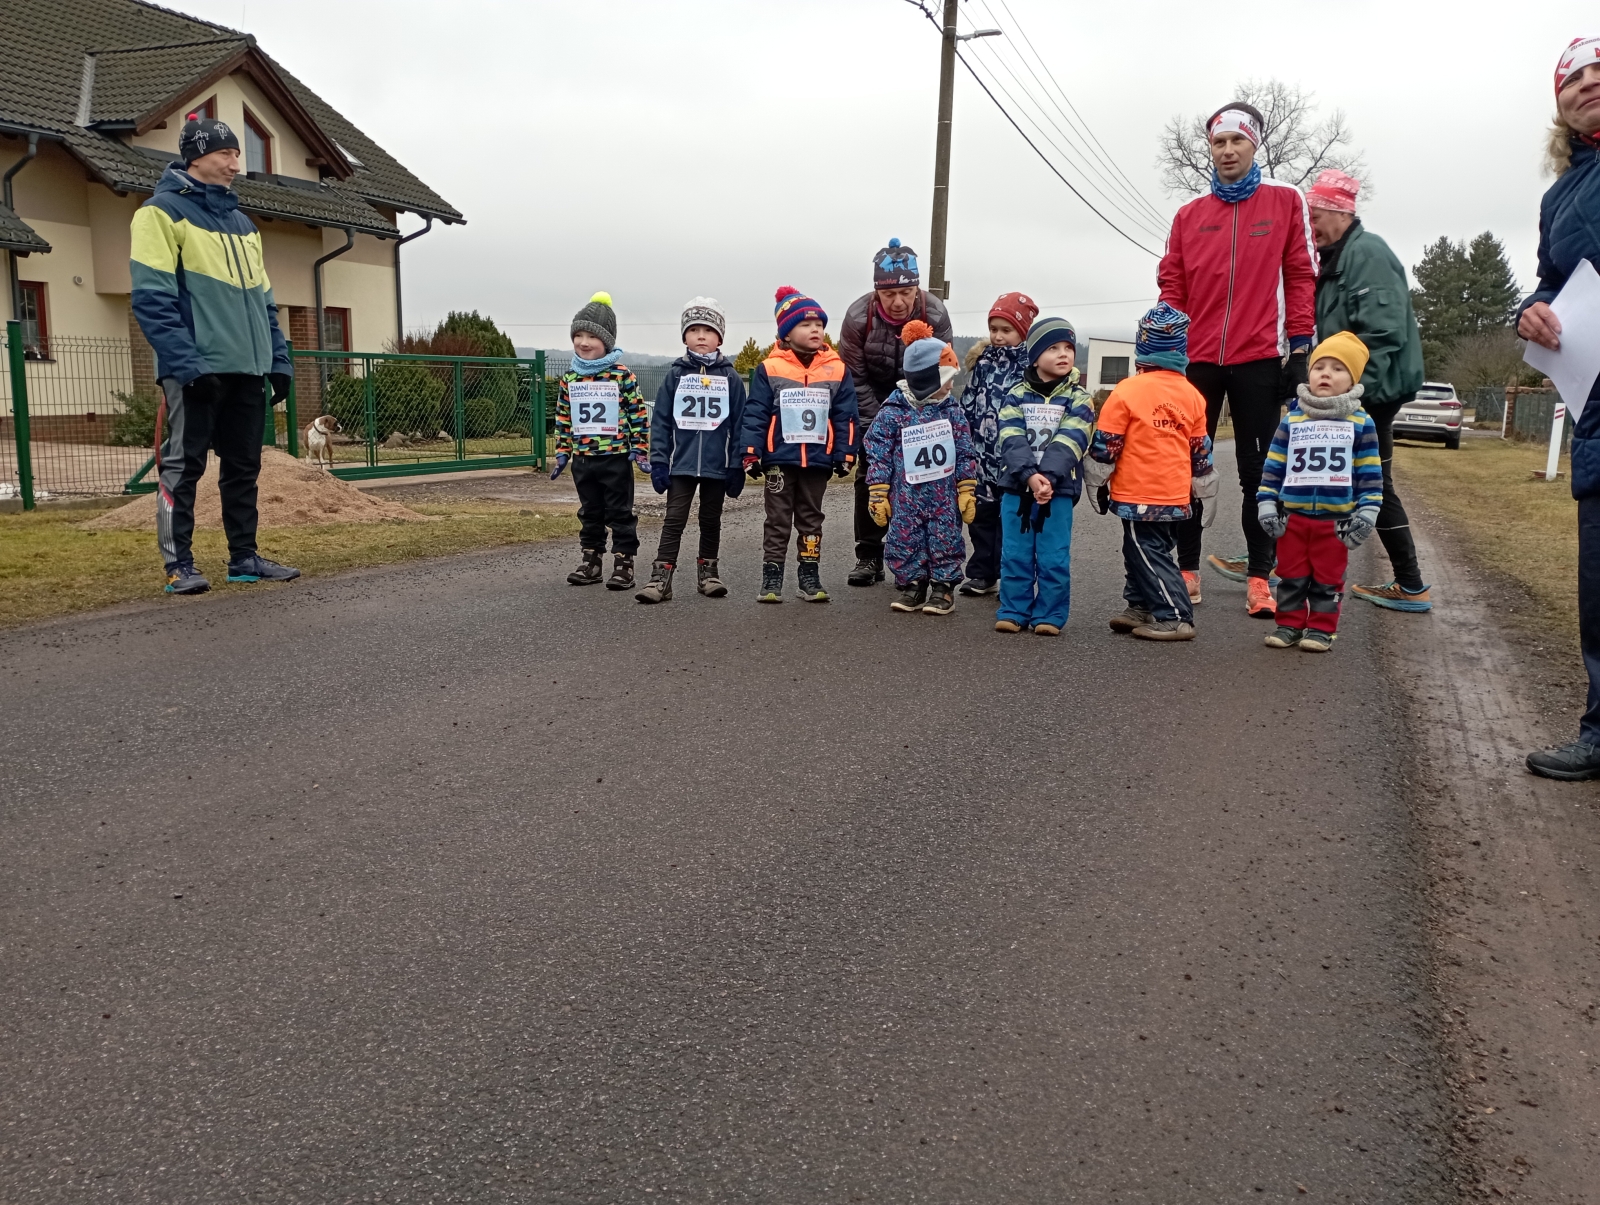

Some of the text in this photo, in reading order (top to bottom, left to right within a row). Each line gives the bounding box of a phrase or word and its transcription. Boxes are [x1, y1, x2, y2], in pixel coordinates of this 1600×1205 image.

[570, 384, 589, 392] ZIMNÍ
[782, 390, 806, 398] ZIMNÍ
[579, 402, 607, 424] 52
[681, 395, 722, 419] 215
[801, 409, 817, 431] 9
[903, 426, 925, 438] ZIMNÍ
[935, 429, 951, 438] LIGA
[1292, 424, 1316, 435] ZIMNÍ
[914, 443, 947, 470] 40
[1291, 446, 1346, 473] 355
